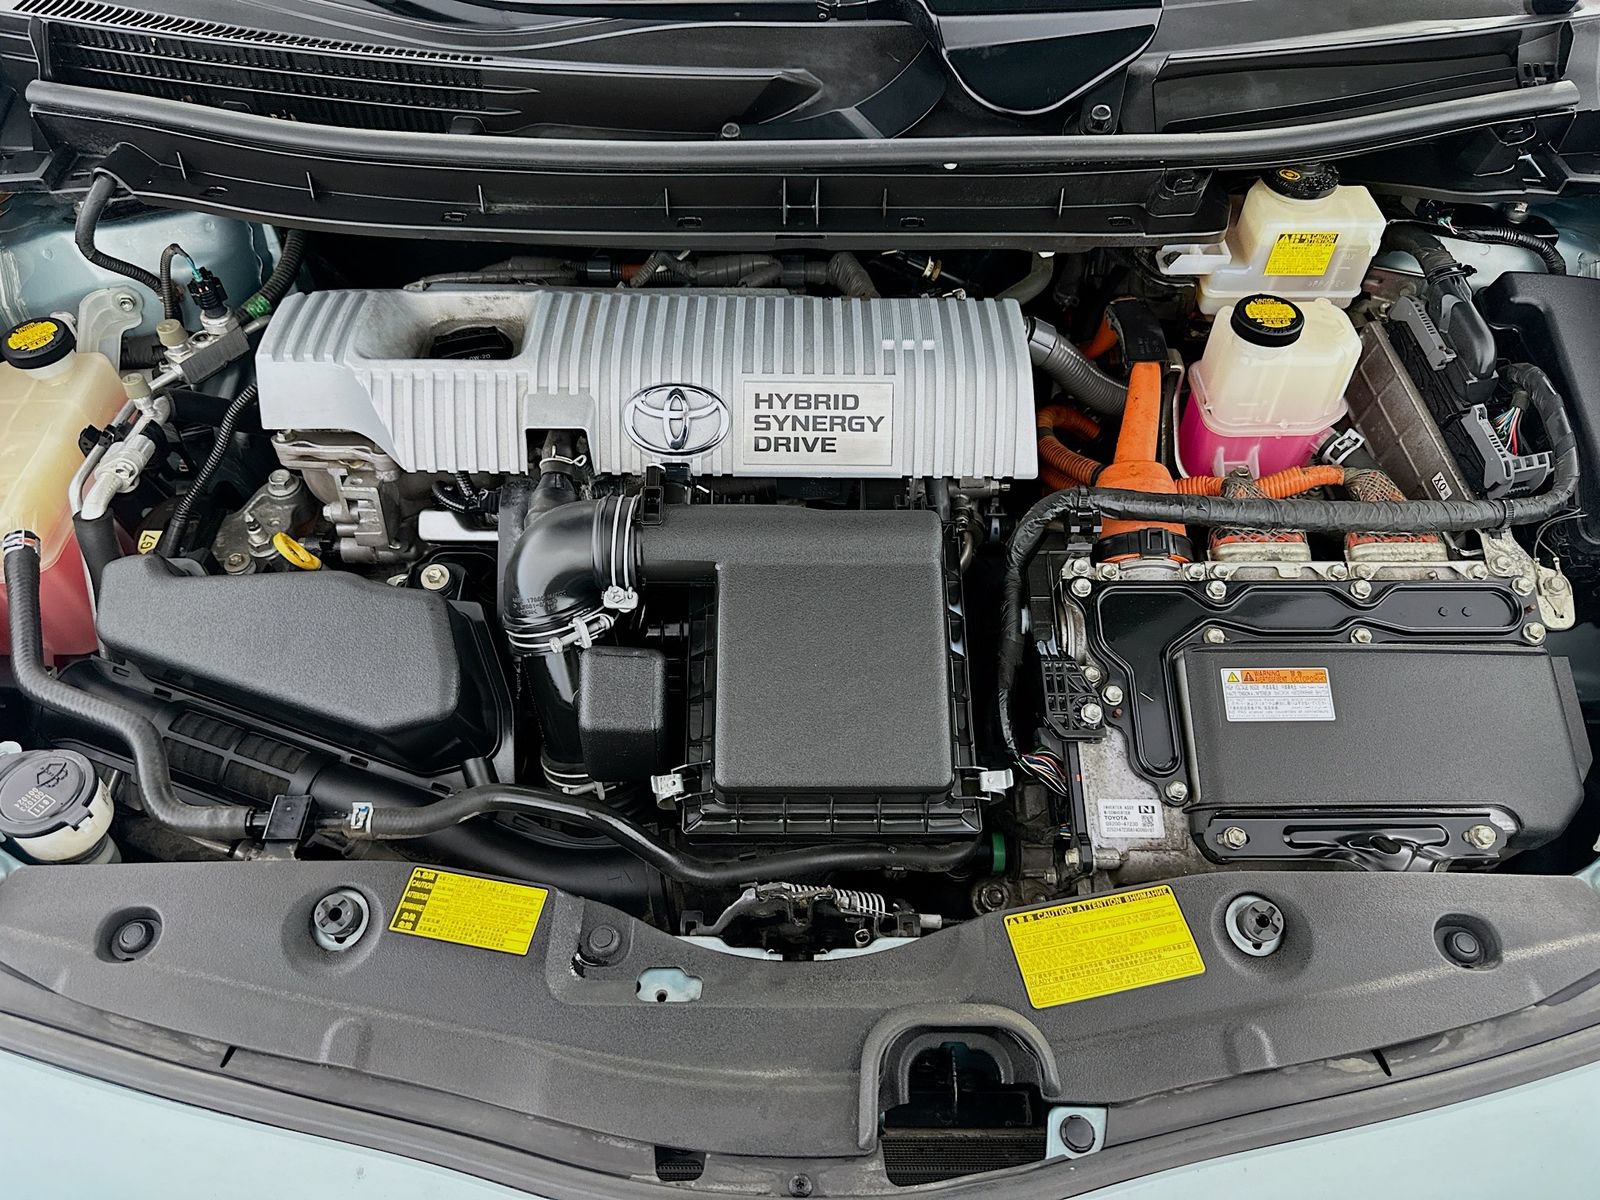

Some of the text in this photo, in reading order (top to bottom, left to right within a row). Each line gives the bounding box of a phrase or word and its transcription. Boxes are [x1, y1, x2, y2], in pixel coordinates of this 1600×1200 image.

[754, 393, 860, 410] HYBRID
[754, 414, 885, 432] SYNERGY
[754, 436, 837, 453] DRIVE
[141, 535, 155, 549] G7
[411, 879, 434, 889] CAUTION
[1125, 888, 1169, 903] ВНИМАНИЕ
[1037, 906, 1073, 919] CAUTION
[1077, 897, 1122, 912] ATTENTION
